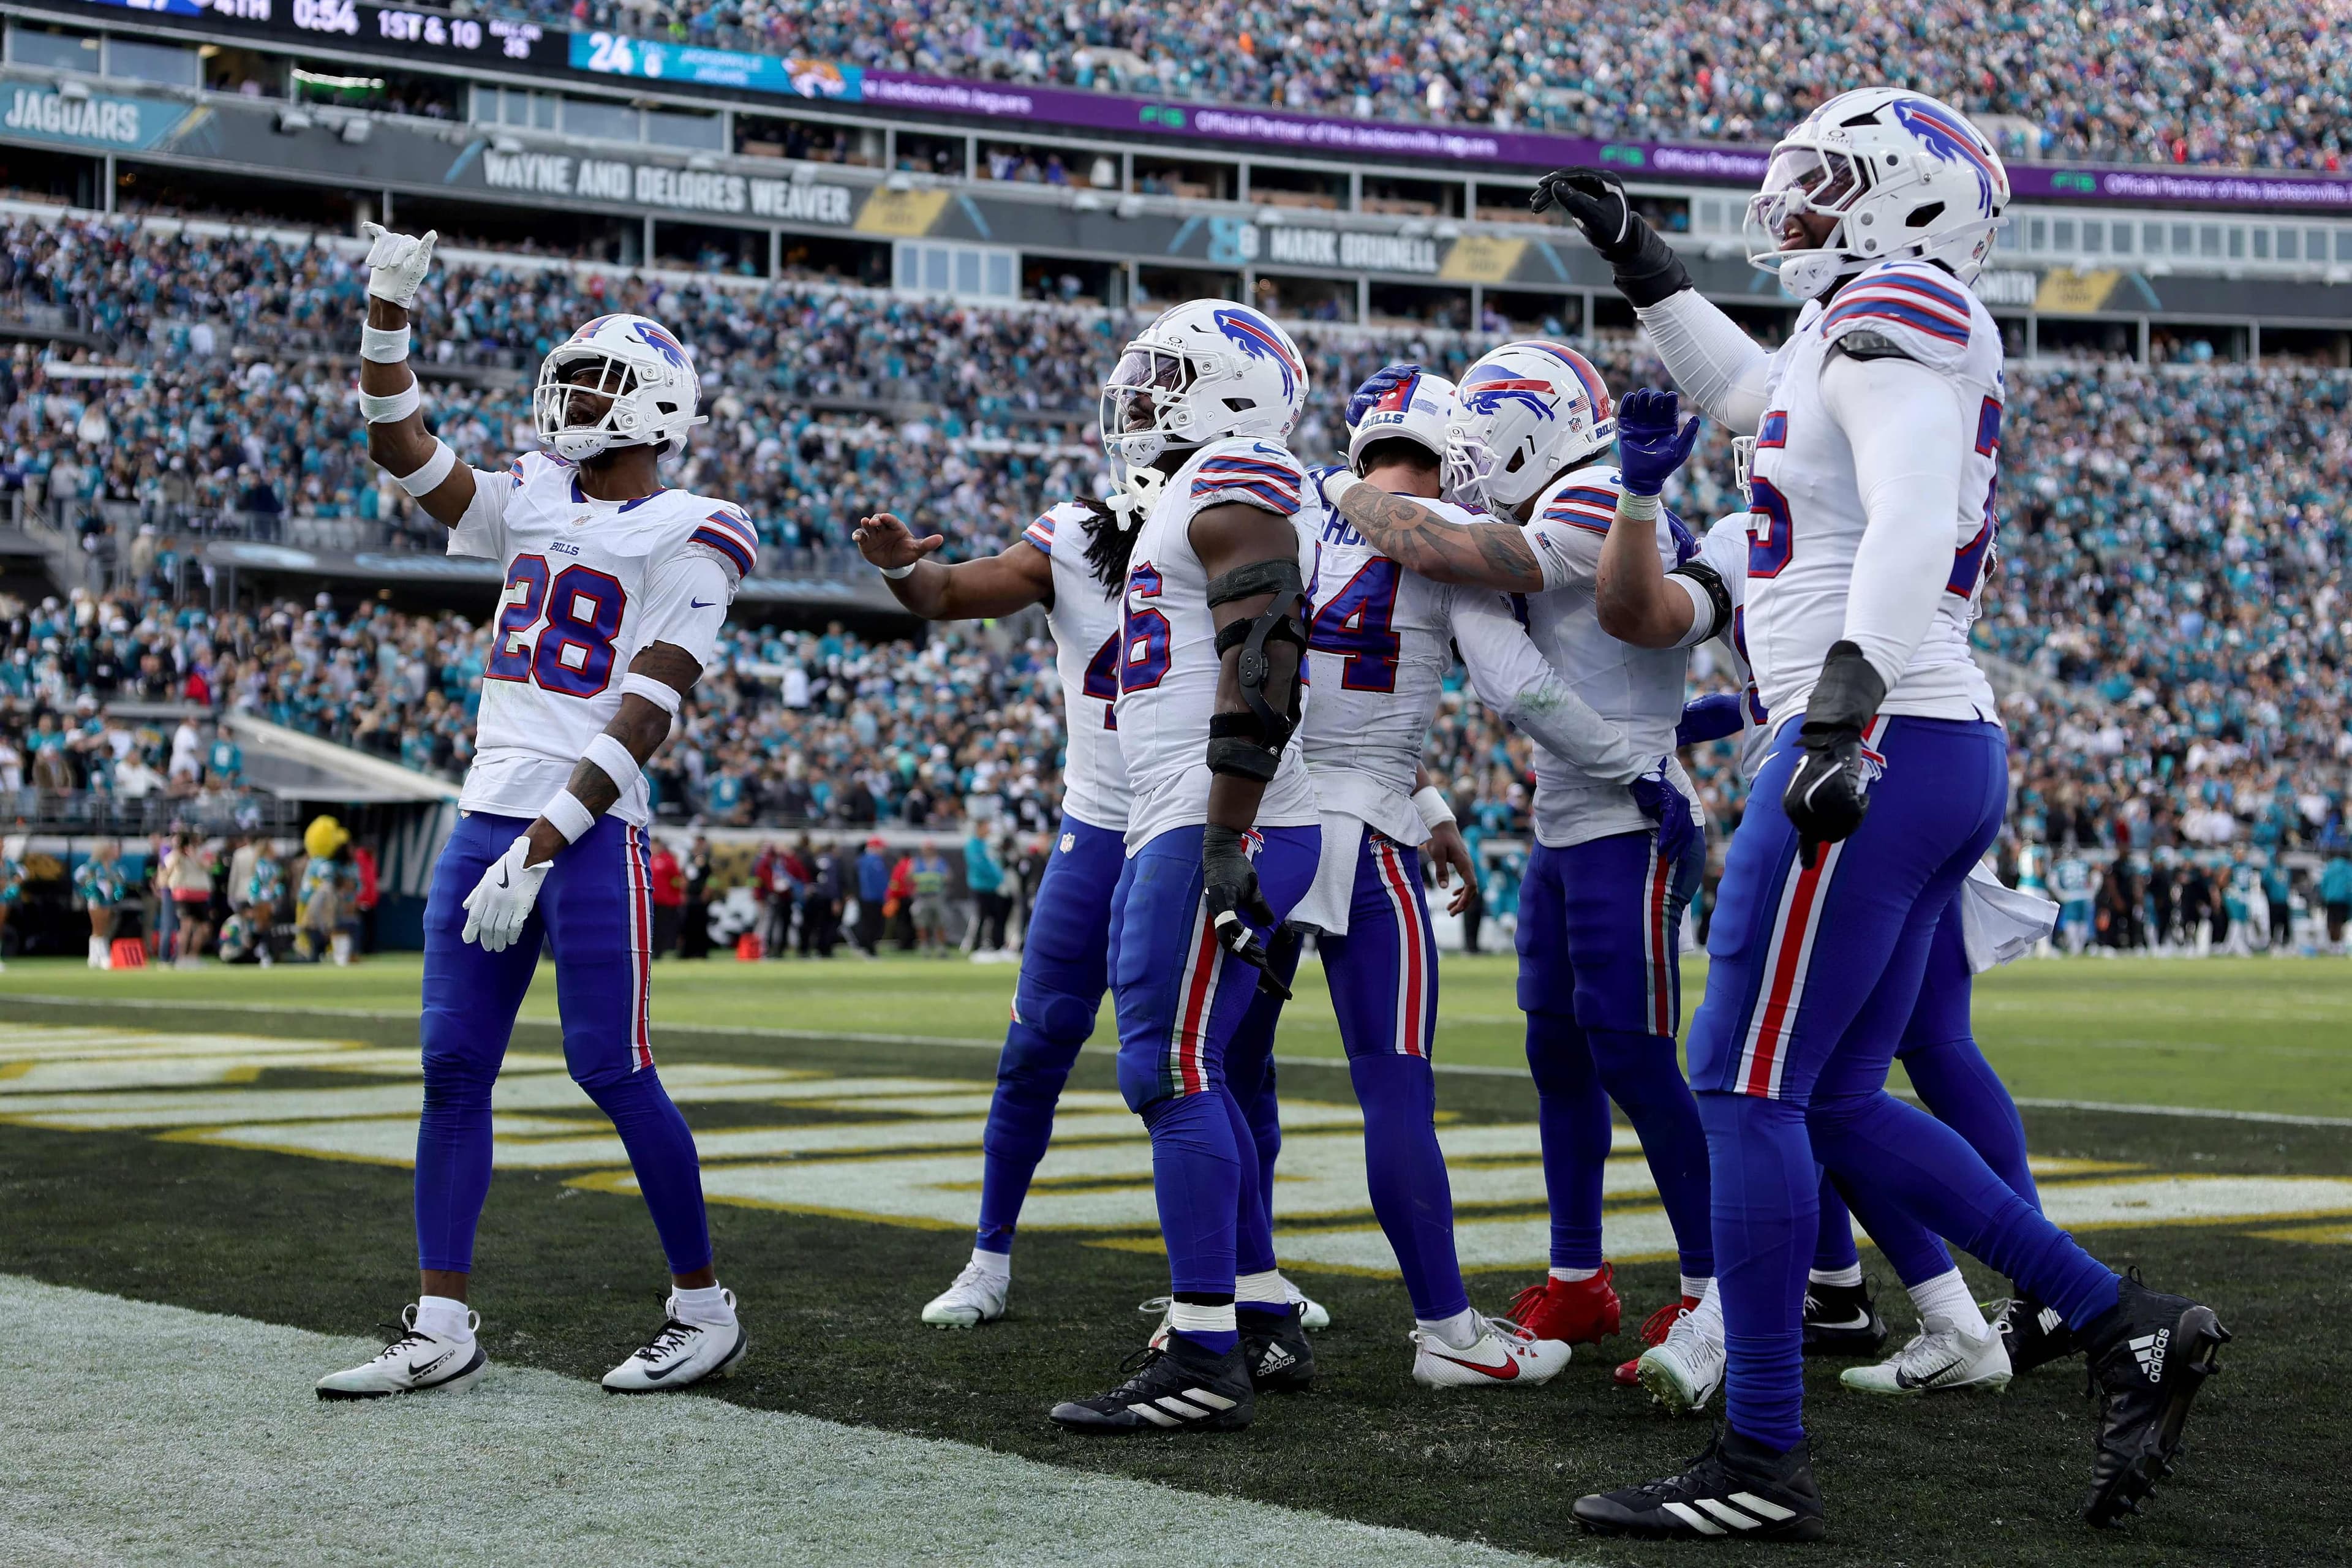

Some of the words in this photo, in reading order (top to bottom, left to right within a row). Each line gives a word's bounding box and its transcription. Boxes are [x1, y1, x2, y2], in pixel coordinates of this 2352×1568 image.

[293, 0, 360, 36] 0:54
[378, 10, 424, 42] 1ST
[450, 19, 482, 50] 10
[587, 32, 633, 75] 24
[4, 88, 140, 143] JAGUARS
[483, 148, 573, 194] WAYNE
[576, 159, 631, 202] AND
[635, 165, 747, 213] DELORES
[750, 178, 853, 224] WEAVER
[1270, 227, 1338, 264] MARK
[1361, 412, 1405, 431] BILLS
[549, 541, 580, 557] BILLS
[483, 553, 628, 699] 28
[1256, 1354, 1297, 1378] adidas
[2149, 1328, 2170, 1383] adidas
